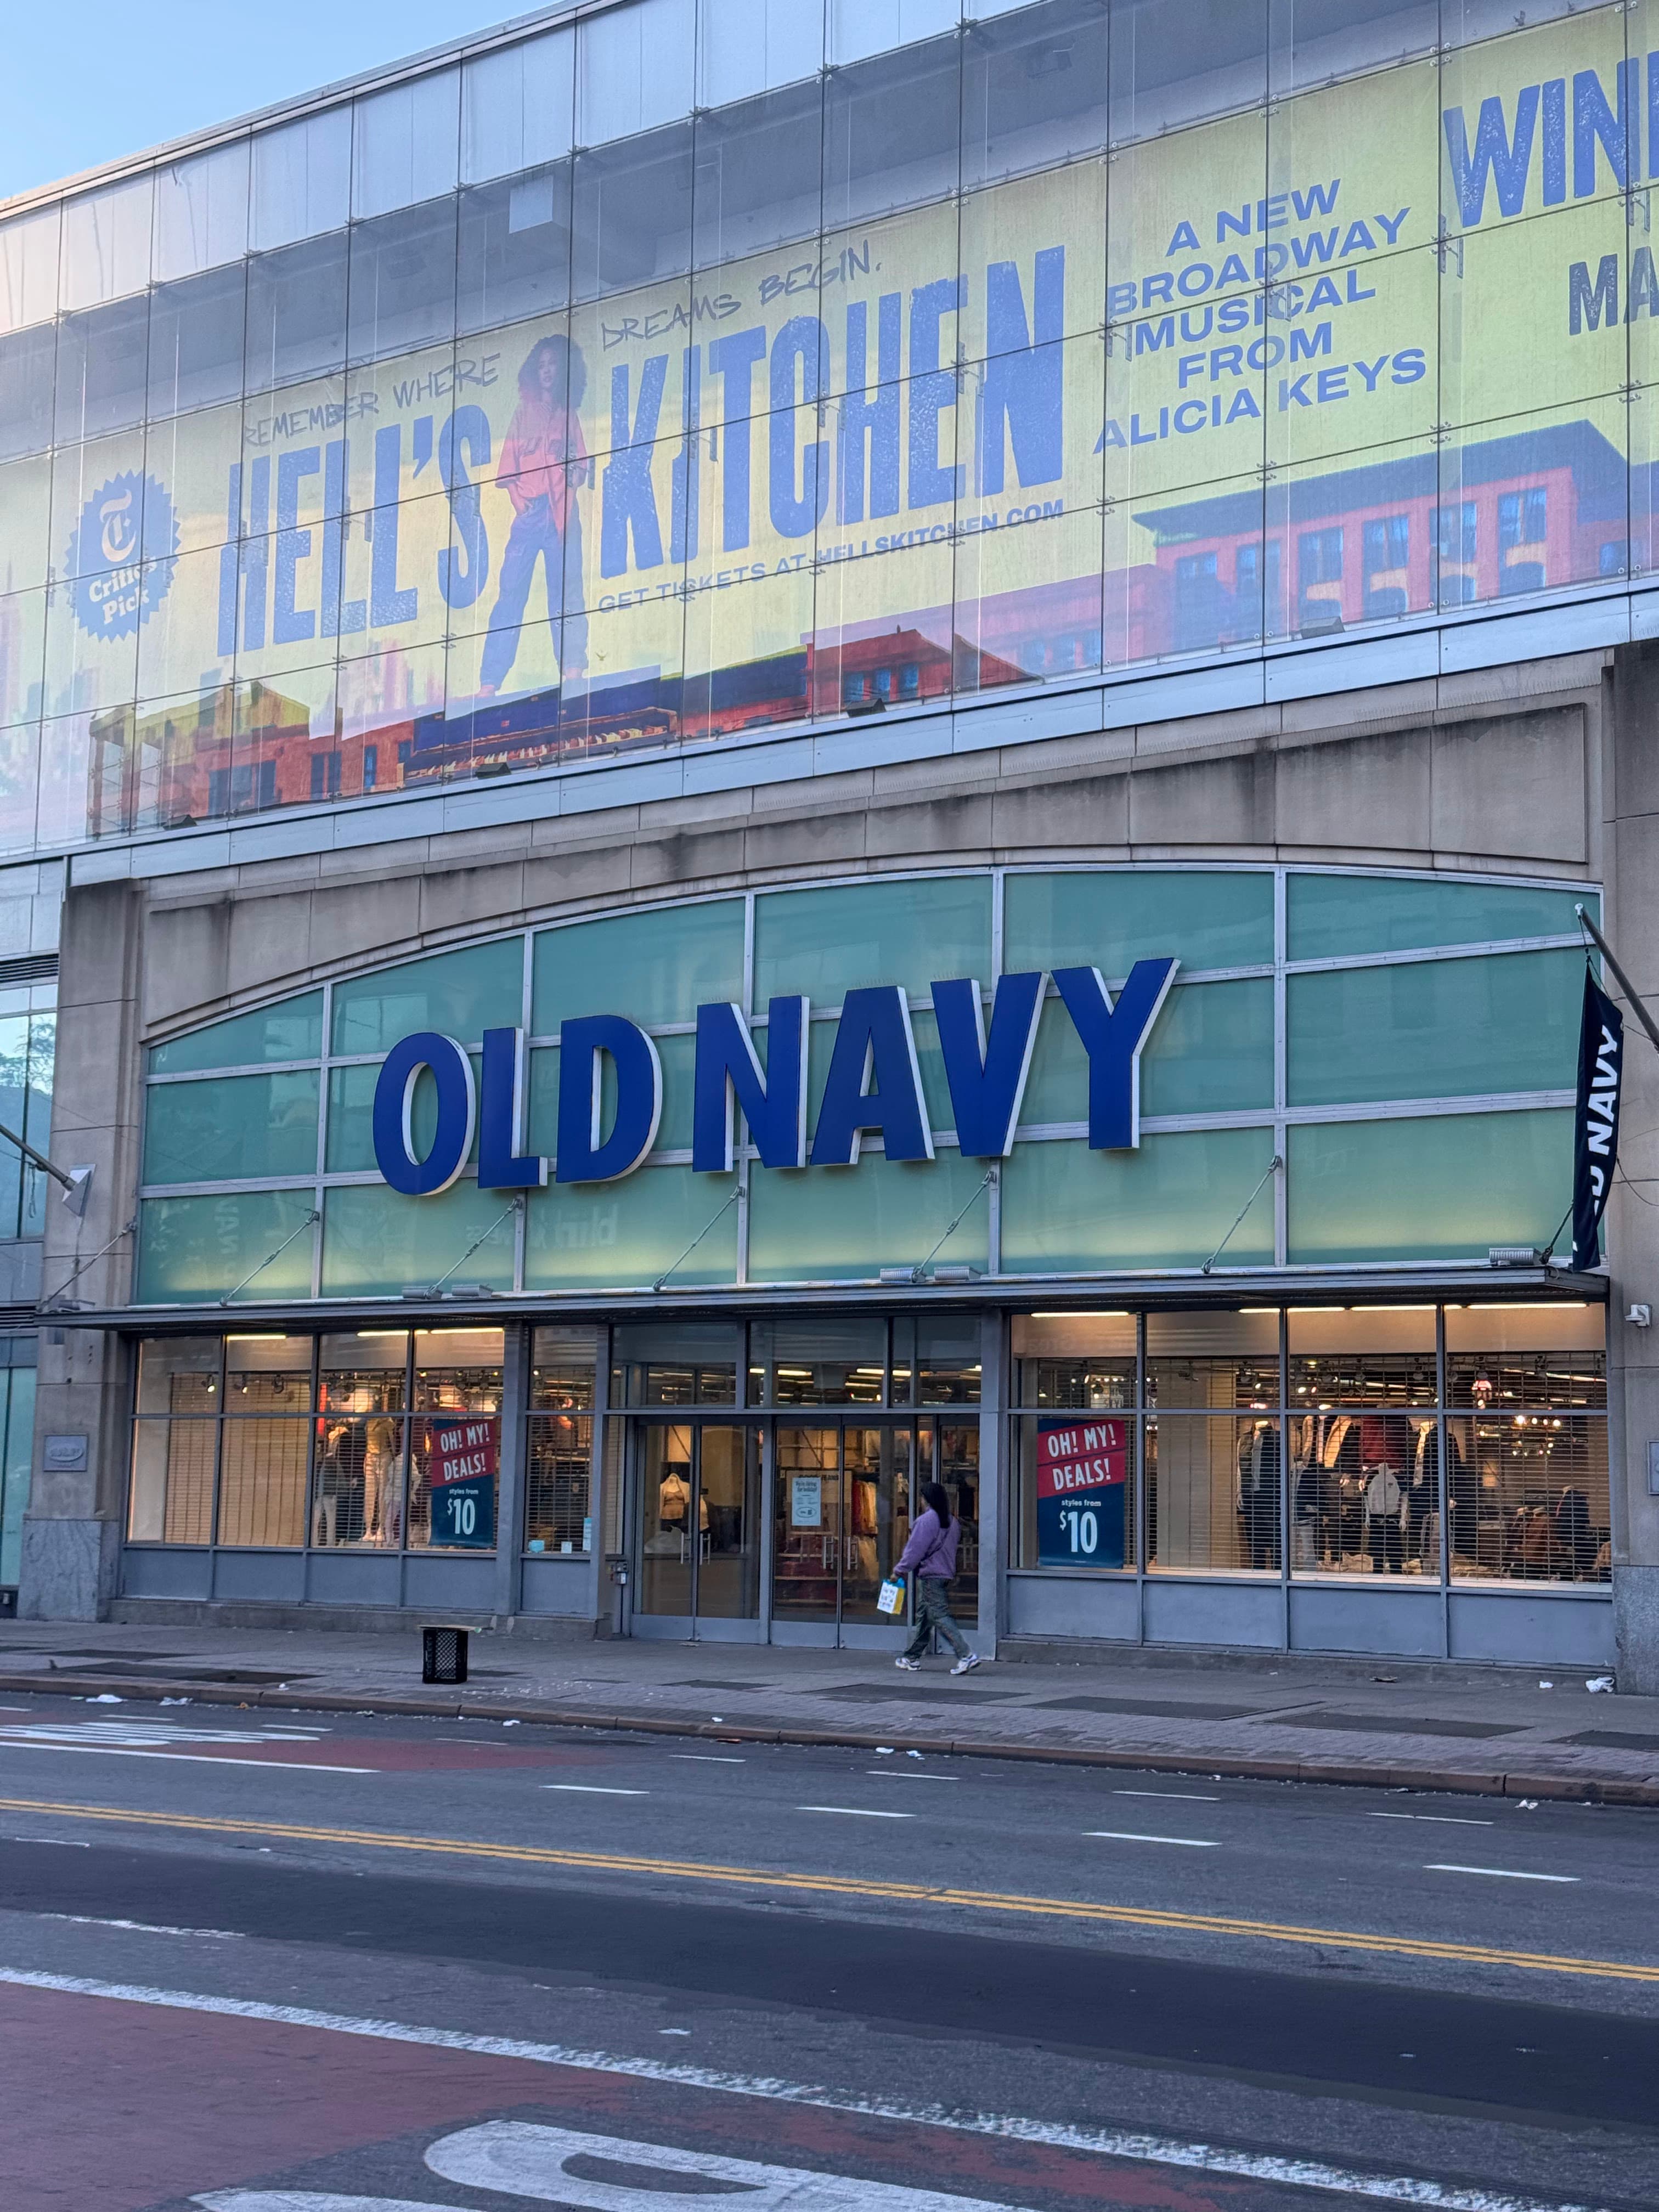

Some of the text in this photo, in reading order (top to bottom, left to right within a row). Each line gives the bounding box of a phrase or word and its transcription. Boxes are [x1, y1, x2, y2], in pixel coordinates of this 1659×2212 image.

[1442, 50, 1659, 228] WIN
[1166, 178, 1341, 257] A NEW
[1107, 206, 1412, 317] BROADWAY
[601, 294, 742, 352] DREAMS
[1135, 268, 1376, 355] MUSICAL
[1178, 321, 1332, 388] FROM
[243, 352, 501, 447] REMEMBER WHERE
[600, 245, 1065, 580] KITCHEN
[1092, 348, 1427, 455] ALICIA KEYS
[217, 404, 492, 658] HELL'S
[102, 585, 150, 625] Pick
[598, 587, 650, 614] GET
[775, 553, 806, 577] AT
[373, 957, 1181, 1197] OLD NAVY
[1587, 1024, 1618, 1156] NAVY
[441, 1423, 490, 1452] OH! MY!
[443, 1452, 486, 1481] DEALS!
[1048, 1424, 1116, 1458] OH! MY!
[1052, 1458, 1111, 1491] DEALS!
[1061, 1499, 1102, 1508] styles from
[447, 1497, 476, 1535] $10
[1059, 1510, 1098, 1554] $10
